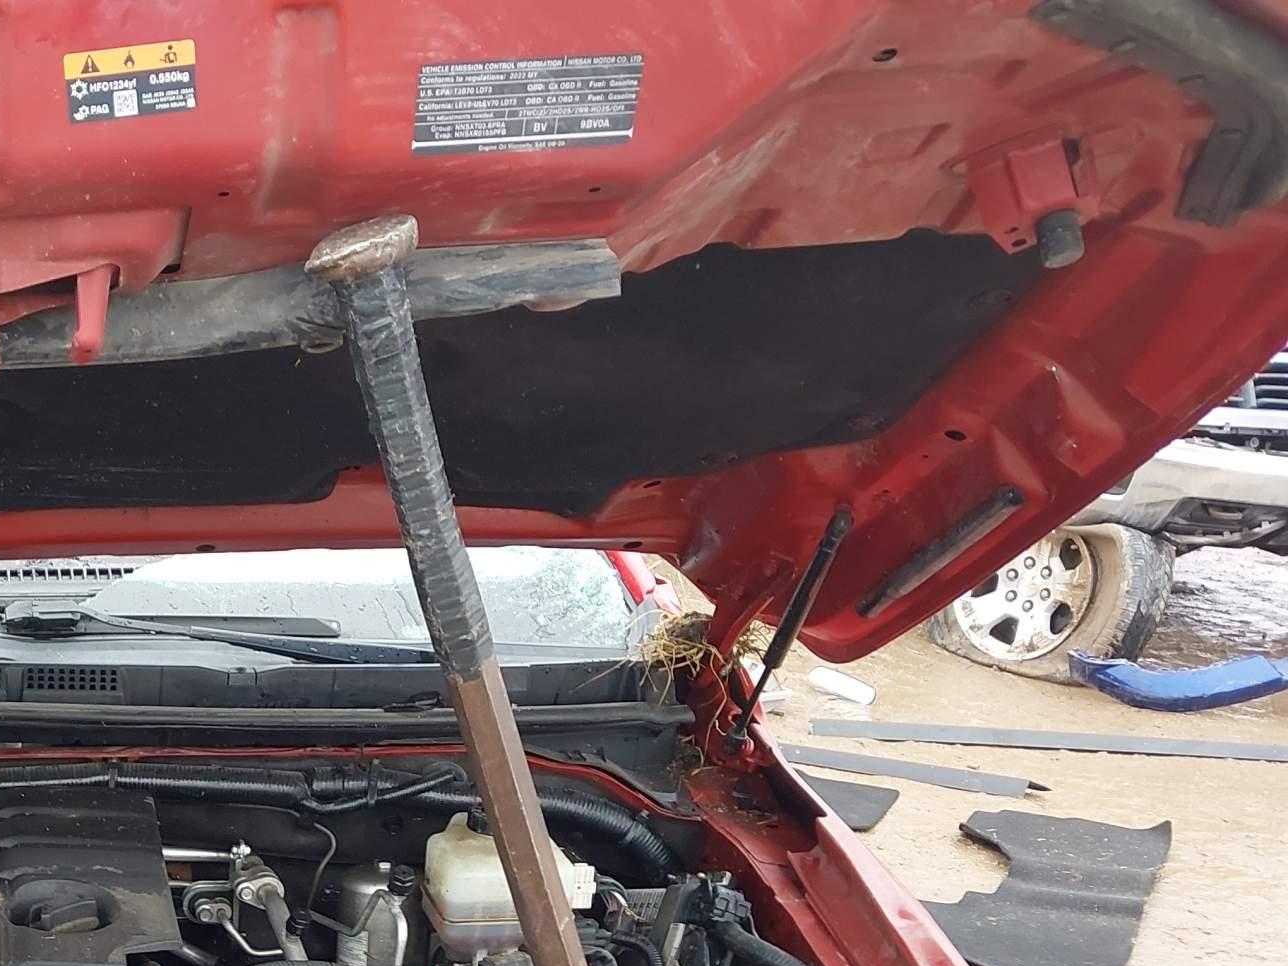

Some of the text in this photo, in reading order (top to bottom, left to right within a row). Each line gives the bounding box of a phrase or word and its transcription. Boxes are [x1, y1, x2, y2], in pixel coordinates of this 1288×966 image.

[568, 57, 592, 66] NISSAN
[593, 56, 616, 65] MOTOR
[630, 54, 642, 63] LTD
[422, 59, 562, 74] VEHICLE EMISSION CONTROL INFORMATION
[420, 76, 454, 85] Conforms
[455, 75, 463, 84] to
[464, 74, 506, 84] regulations:
[589, 79, 638, 88] Fuel: Gasoline
[89, 78, 137, 92] HFO1234yf
[527, 83, 545, 92] OBD:
[548, 82, 558, 90] CA
[559, 81, 575, 89] OBD
[419, 89, 434, 98] U.S.
[587, 92, 636, 102] Fuel: Gasoline
[525, 98, 544, 106] OBD:
[546, 96, 557, 104] CA
[558, 96, 574, 104] OBD
[90, 104, 110, 115] PAG
[418, 102, 454, 111] California:
[430, 124, 452, 133] Group:
[533, 122, 548, 132] BV
[478, 144, 497, 152] Engine
